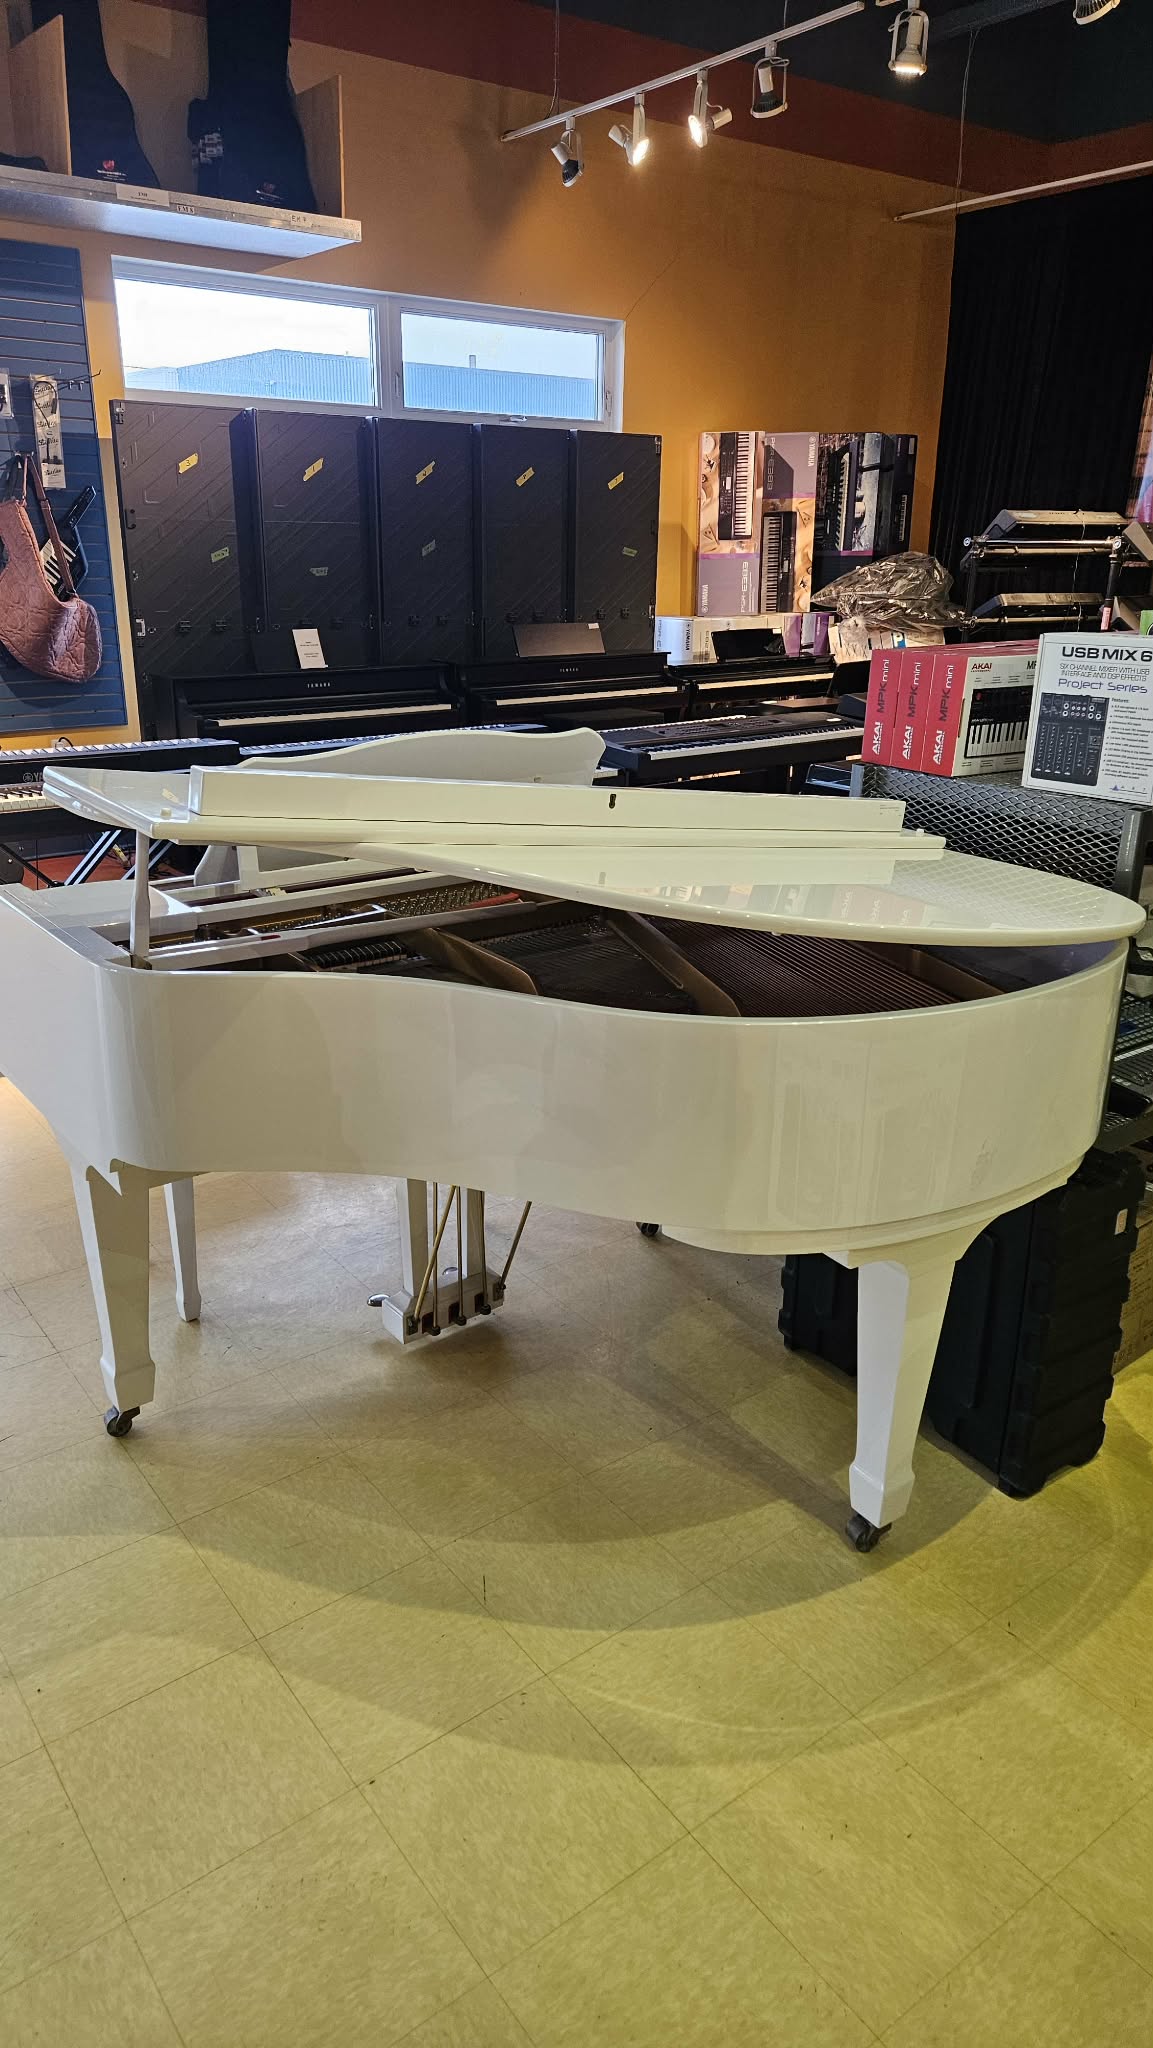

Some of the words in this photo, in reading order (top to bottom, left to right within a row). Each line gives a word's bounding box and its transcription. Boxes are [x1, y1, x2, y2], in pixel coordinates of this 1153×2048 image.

[807, 443, 816, 467] YAMAHA
[701, 584, 709, 607] YAMAHA
[1062, 646, 1100, 659] USB
[1102, 648, 1138, 662] MIX
[1141, 650, 1153, 663] 6
[971, 662, 993, 670] AKAI
[1069, 664, 1098, 672] CHANNEL
[1099, 665, 1118, 673] MIXER
[1137, 668, 1150, 676] USB
[1060, 670, 1092, 678] INTERFACE
[1107, 672, 1120, 680] DSP
[1120, 674, 1147, 682] EFFECTS
[1058, 678, 1104, 690] Project
[1107, 682, 1148, 694] Series
[872, 721, 882, 755] AKAI
[902, 725, 912, 760] AKAI
[933, 730, 943, 765] AKAI
[33, 772, 43, 782] YA
